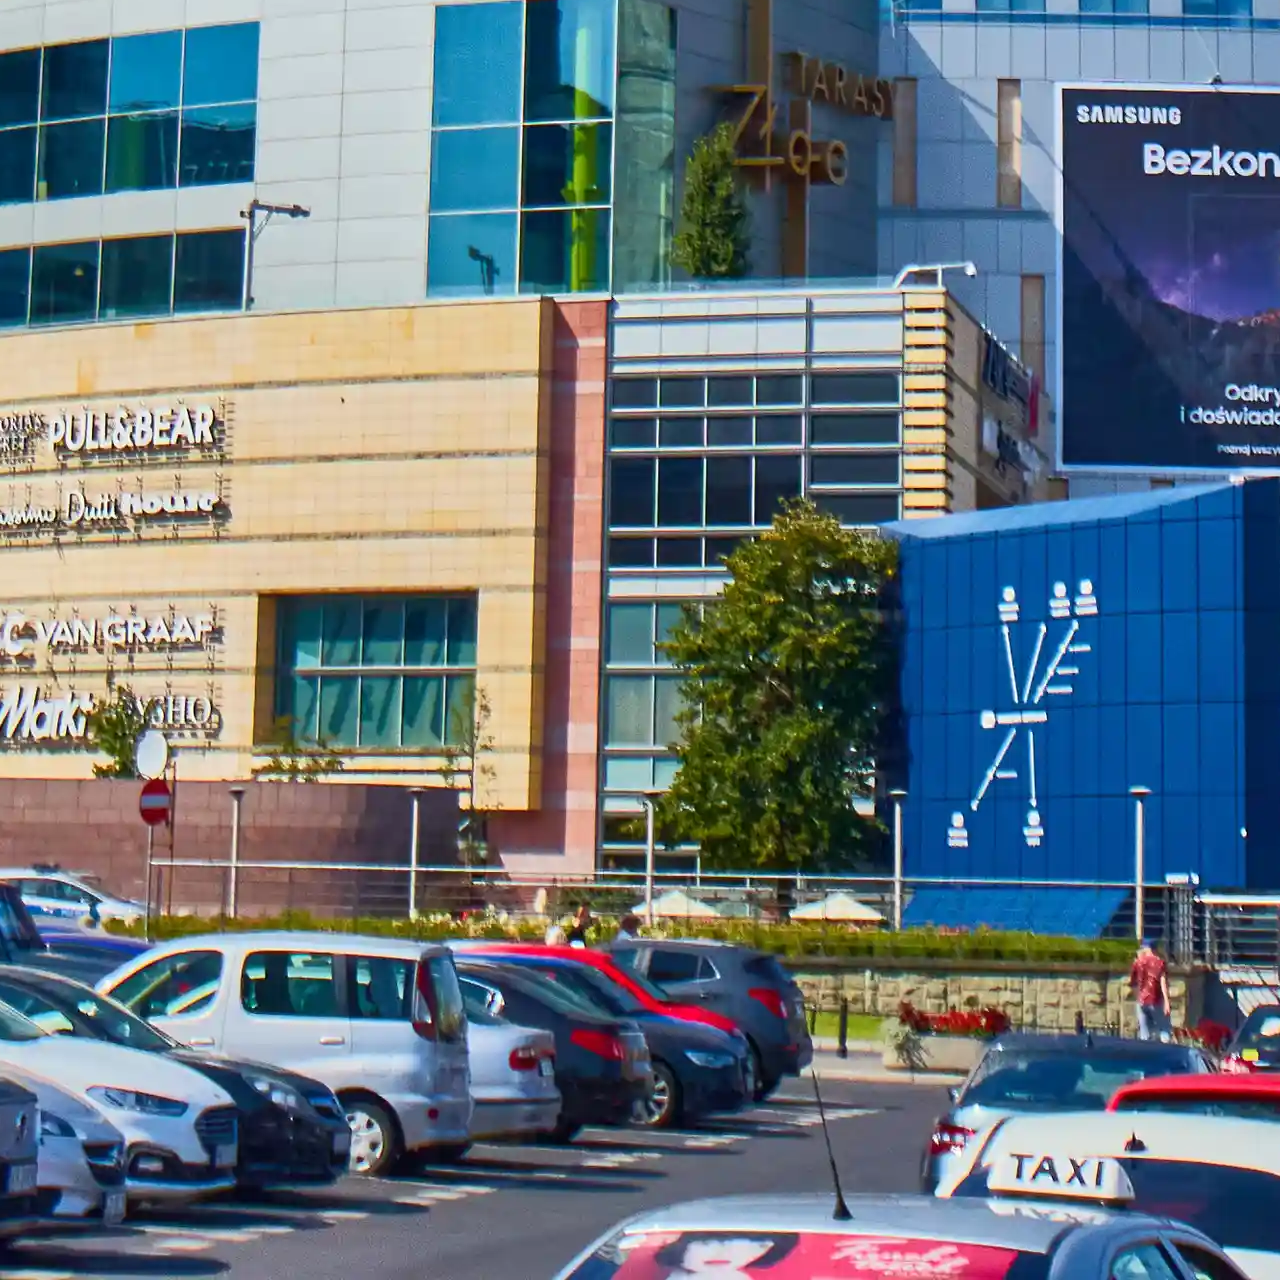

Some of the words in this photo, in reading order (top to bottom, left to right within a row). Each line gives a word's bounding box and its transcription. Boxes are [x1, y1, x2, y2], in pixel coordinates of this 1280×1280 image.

[1076, 104, 1182, 126] SAMSUNG
[48, 405, 215, 454] PULL&BEAR
[1180, 405, 1185, 424] i
[64, 490, 118, 525] Dutti
[35, 617, 97, 646] VAN
[102, 614, 213, 645] GRAAF
[1010, 1152, 1105, 1188] TAXI
